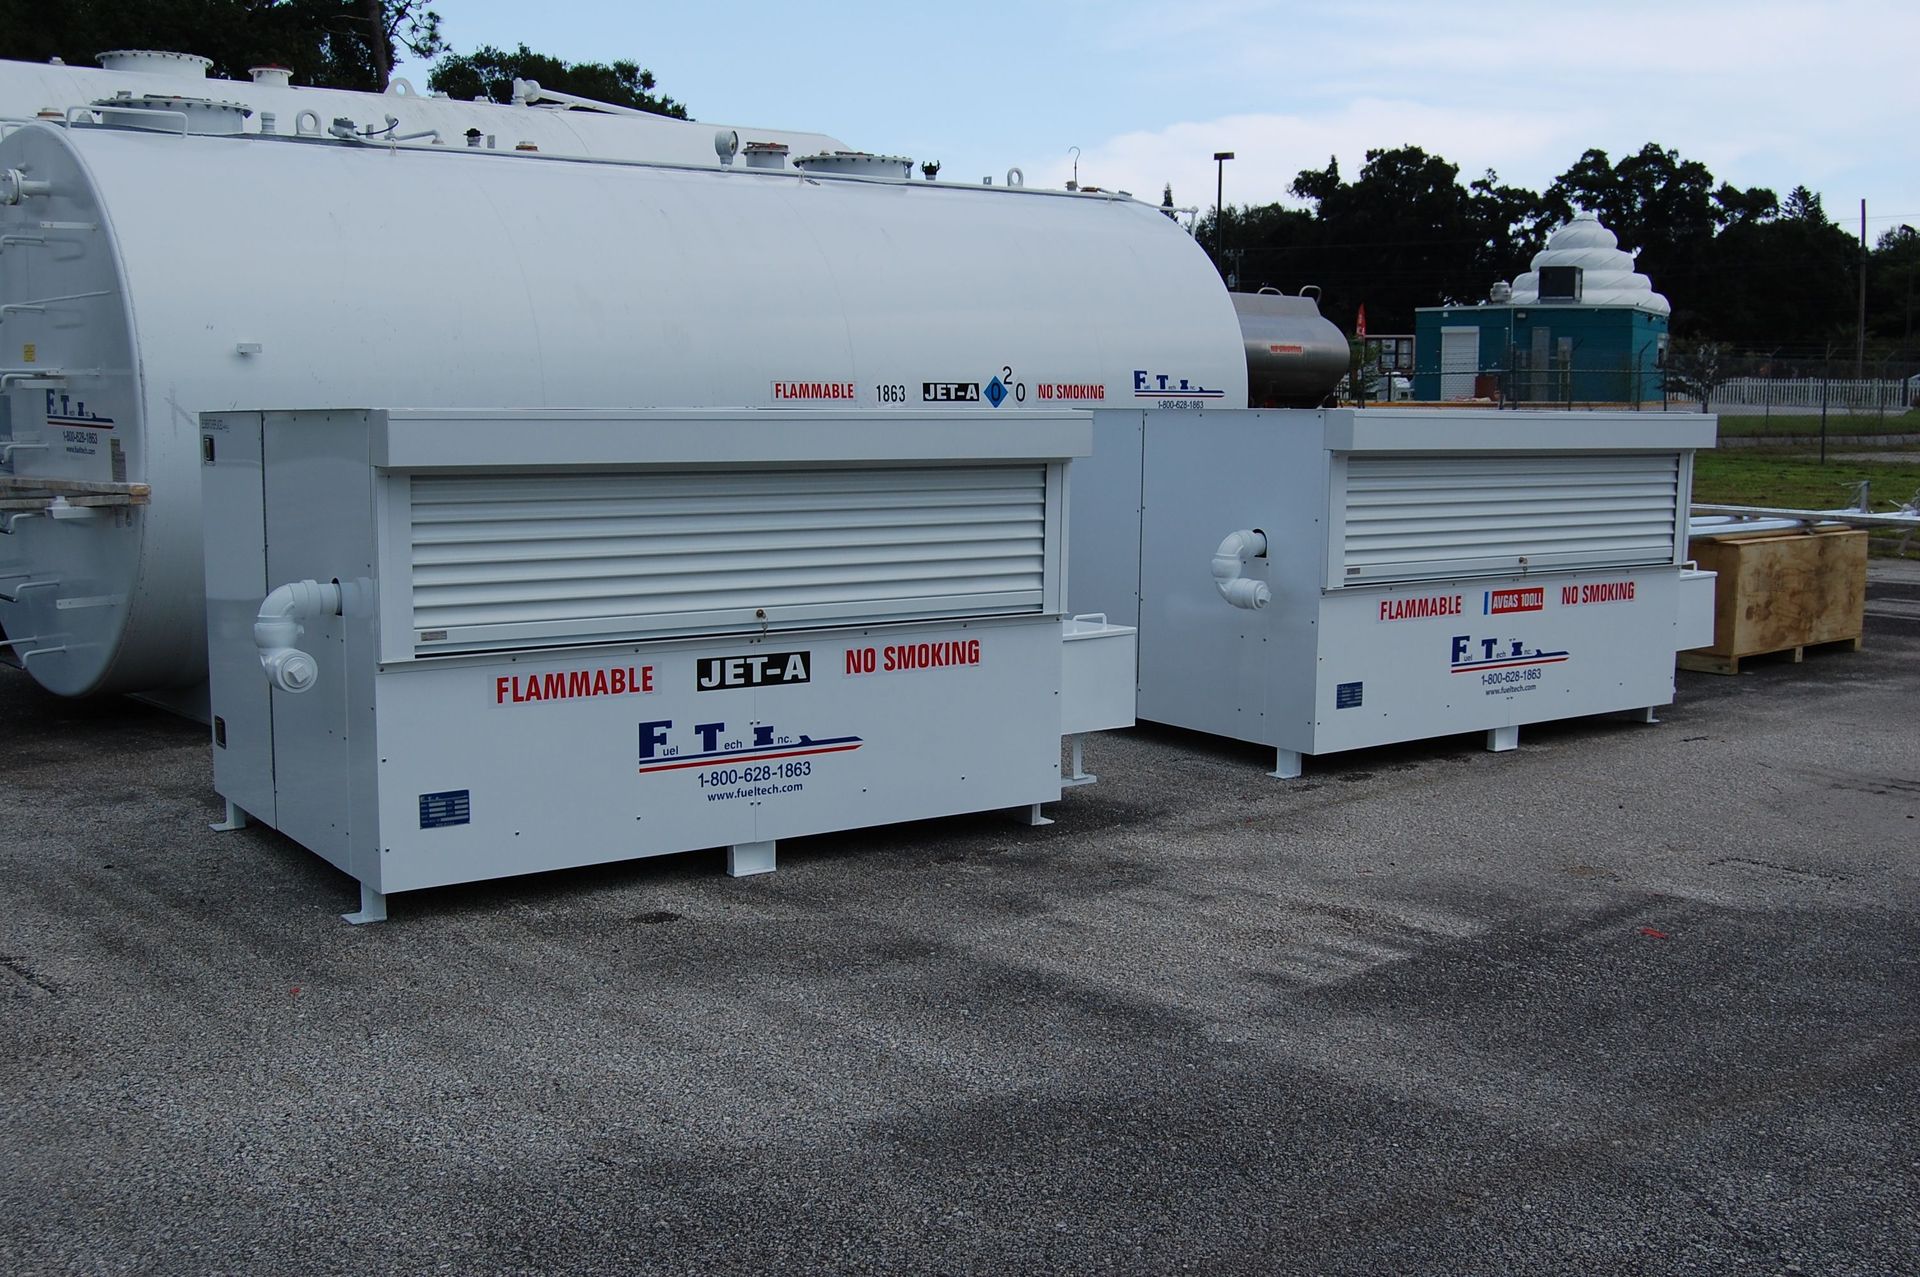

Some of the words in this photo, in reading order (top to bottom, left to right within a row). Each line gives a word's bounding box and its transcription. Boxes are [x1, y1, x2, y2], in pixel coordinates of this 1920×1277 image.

[1002, 366, 1013, 385] 2
[775, 383, 854, 399] FLAMMABLE
[876, 384, 906, 402] 1863
[924, 384, 979, 400] JET-A
[1038, 384, 1053, 399] NO
[1056, 384, 1105, 400] SMOKING
[1158, 400, 1204, 409] 1-800-628-1863
[1493, 594, 1519, 609] AVGAS
[1521, 592, 1543, 607] 100LL
[1561, 586, 1578, 605] NO
[1582, 581, 1635, 602] SMOKING
[1380, 595, 1462, 621] FLAMMABLE
[846, 647, 876, 674] NO
[883, 639, 980, 671] SMOKING
[700, 654, 807, 687] JET-A
[1481, 668, 1542, 686] 1-800-628-1863
[496, 665, 654, 704] FLAMMABLE
[1485, 683, 1537, 696] www.fueltech.com
[697, 760, 812, 788] 1-800-628-1863
[707, 782, 803, 802] www.fueltech.com
